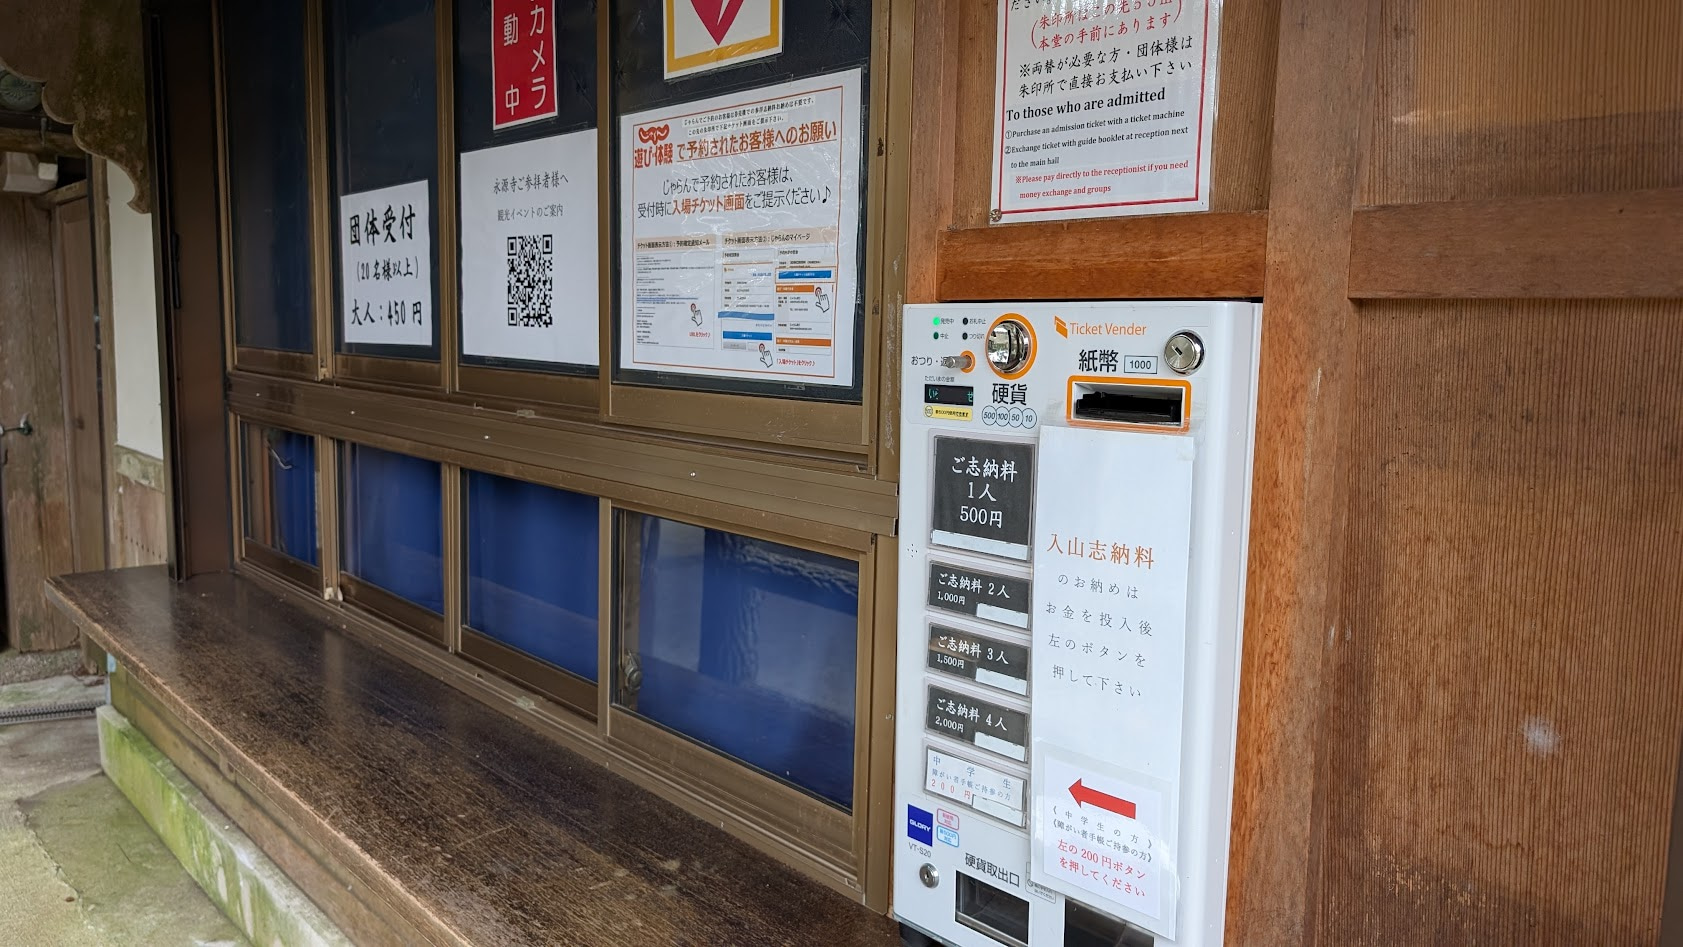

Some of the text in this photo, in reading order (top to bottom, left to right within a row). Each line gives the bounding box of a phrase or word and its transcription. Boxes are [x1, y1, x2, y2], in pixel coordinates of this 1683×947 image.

[1019, 61, 1192, 98] 朱印所で直接お支払い下さい
[1006, 87, 1166, 121] To those who are admitted
[1051, 123, 1085, 133] admission
[1087, 119, 1106, 129] ticket
[1107, 117, 1123, 126] with
[1130, 114, 1151, 123] ticket
[1152, 110, 1185, 120] machine
[677, 120, 838, 160] で予約されたお客様へのお願い
[1042, 142, 1060, 150] ticket
[1061, 139, 1076, 148] with
[1077, 137, 1097, 148] guide
[1098, 133, 1125, 144] booklet
[1134, 128, 1170, 140] reception
[1171, 126, 1189, 135] next
[1018, 160, 1029, 168] the
[1030, 158, 1046, 167] main
[1047, 157, 1060, 165] hall
[1043, 174, 1055, 183] pay
[1056, 170, 1081, 180] directly
[1091, 168, 1102, 177] the
[1103, 164, 1147, 176] receptionist
[1147, 163, 1154, 171] if
[1154, 164, 1168, 172] you
[1169, 160, 1189, 170] need
[493, 171, 569, 195] 永源寺ご参拝者様へ
[663, 166, 793, 196] じゃらんで予約されたお客様は、
[1019, 184, 1112, 199] money exchange and groups
[497, 204, 564, 222] 観光イベントのご案内
[349, 204, 416, 247] 団体受付
[1070, 322, 1147, 336] Ticket Vender
[1078, 350, 1152, 373] 紙幣 1000
[992, 383, 1028, 405] 硬貨
[984, 412, 1033, 422] 500 100 50 10
[952, 456, 1018, 482] ご志納料
[968, 482, 997, 502] 1人
[960, 506, 1003, 529] 500円
[1046, 533, 1154, 570] 入山志納料
[937, 572, 1010, 599] ご志納料 2人
[1058, 574, 1138, 599] のお納めは
[937, 591, 966, 605] 1,000円
[1046, 602, 1153, 637] お金を投入後
[937, 635, 1009, 665] ご志納料 3人
[937, 653, 965, 669] 1,500円
[1048, 632, 1146, 668] 左のボタンを
[1052, 665, 1141, 697] 押して下さい
[935, 716, 964, 733] 2,000円
[936, 698, 1008, 732] ご志納料 4人
[909, 819, 931, 832] GLORY
[908, 842, 932, 858] VT-S20
[964, 852, 1020, 888] 硬貨取出口
[1059, 856, 1145, 897] を押してください
